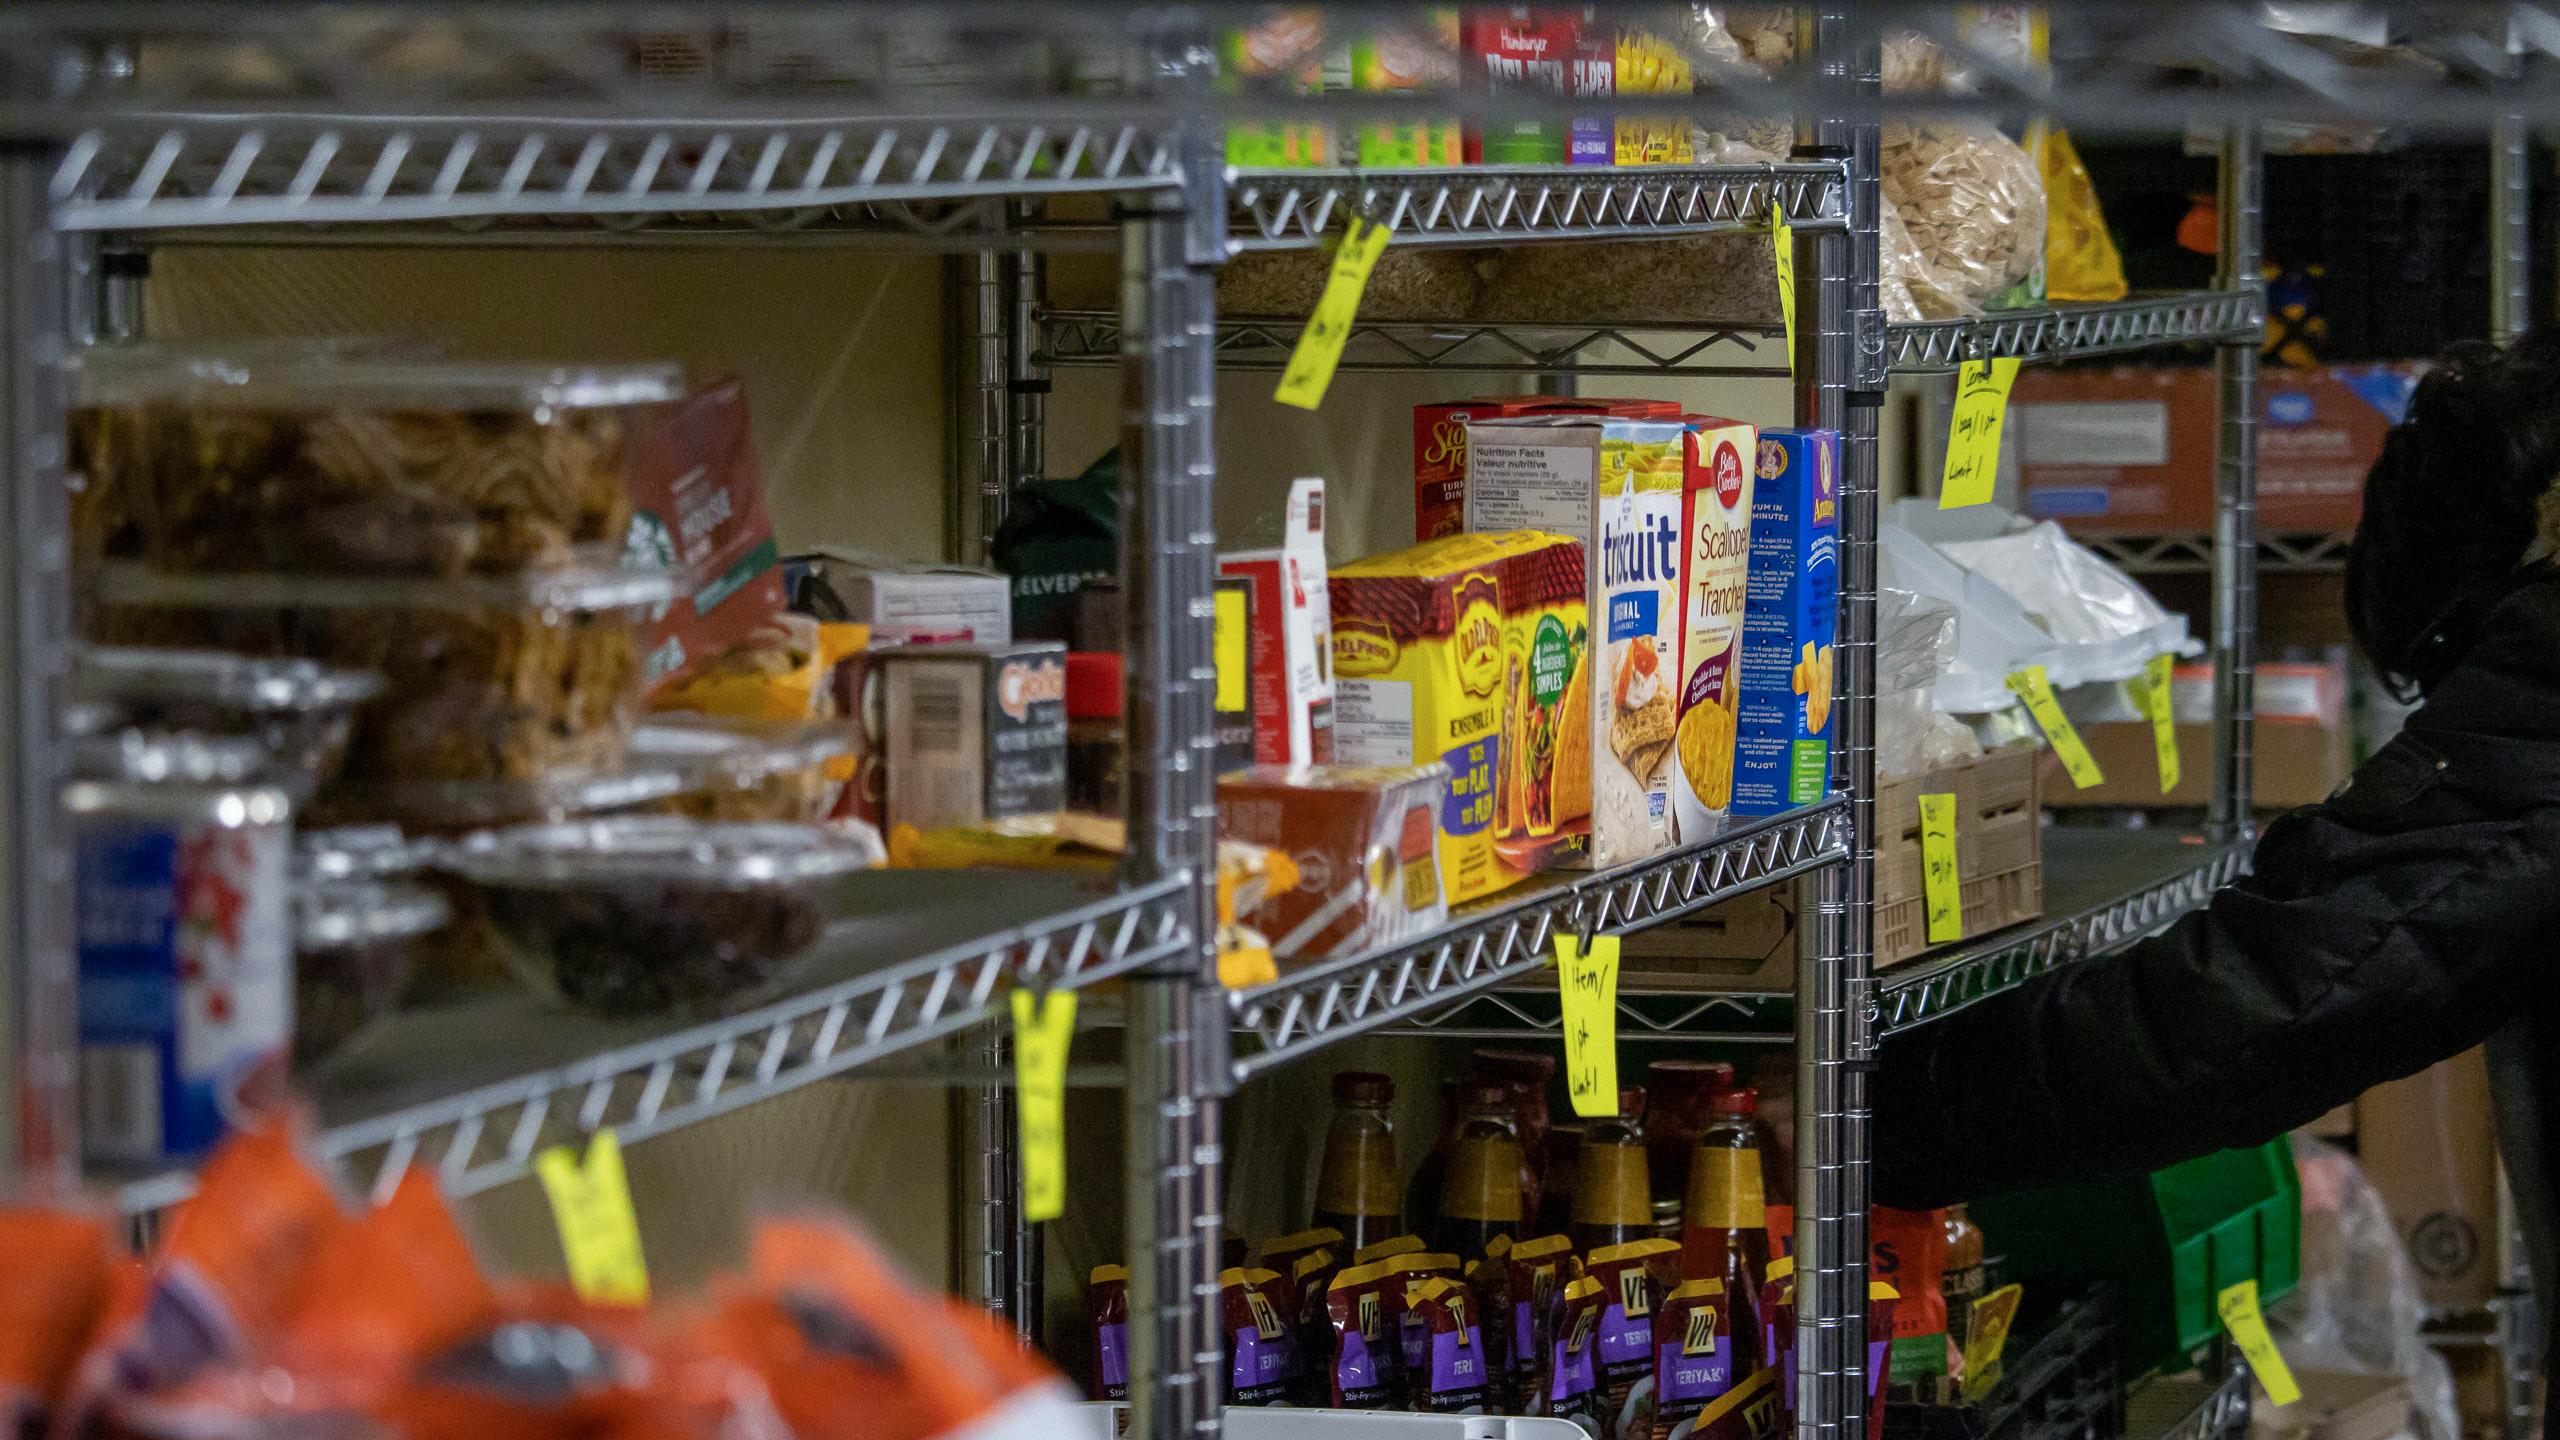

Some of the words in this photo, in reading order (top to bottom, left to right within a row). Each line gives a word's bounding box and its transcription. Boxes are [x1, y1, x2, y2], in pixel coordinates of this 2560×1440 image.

[1501, 27, 1548, 60] Hamburger
[1573, 59, 1612, 99] ELPER
[1425, 421, 1466, 463] Sto
[1476, 448, 1516, 458] Nutrition
[1520, 449, 1545, 458] Facts
[1477, 459, 1505, 469] Valeur
[1508, 460, 1547, 469] nutritive
[1721, 452, 1736, 477] Betty
[1752, 513, 1789, 521] MINUTES
[1604, 514, 1677, 588] triscuit
[1699, 577, 1744, 617] Tranches
[1536, 671, 1563, 695] SIMPLES
[1745, 760, 1777, 769] ENJOY!
[1361, 1300, 1378, 1337] VH
[1688, 1313, 1715, 1348] VH
[1454, 1359, 1473, 1376] TERI
[1110, 1387, 1130, 1399] Stir-F
